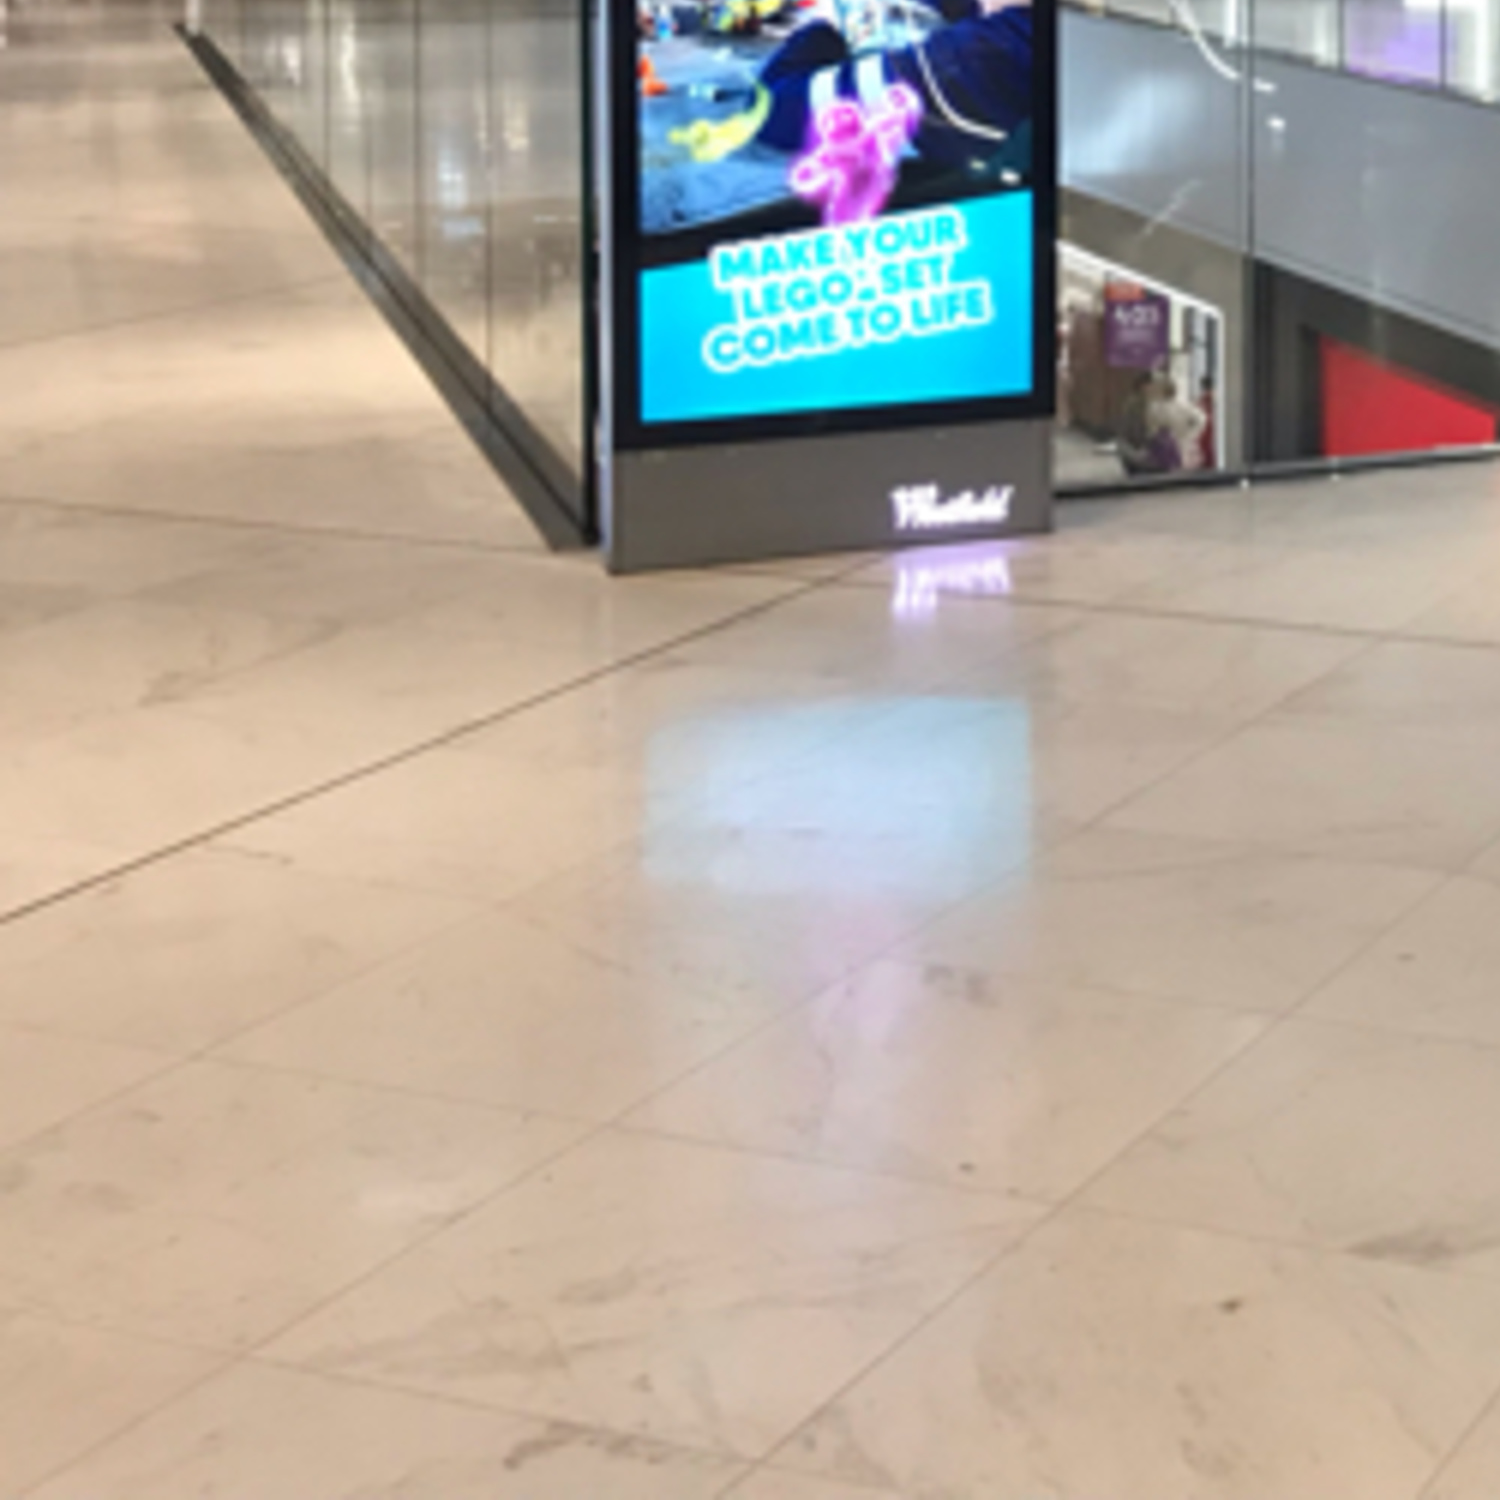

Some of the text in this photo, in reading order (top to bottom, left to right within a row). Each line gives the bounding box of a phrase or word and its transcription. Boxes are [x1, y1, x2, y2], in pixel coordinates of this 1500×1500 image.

[714, 211, 963, 287] MAKE YOUR
[877, 252, 954, 299] SET
[706, 285, 990, 368] COME TO LIFE
